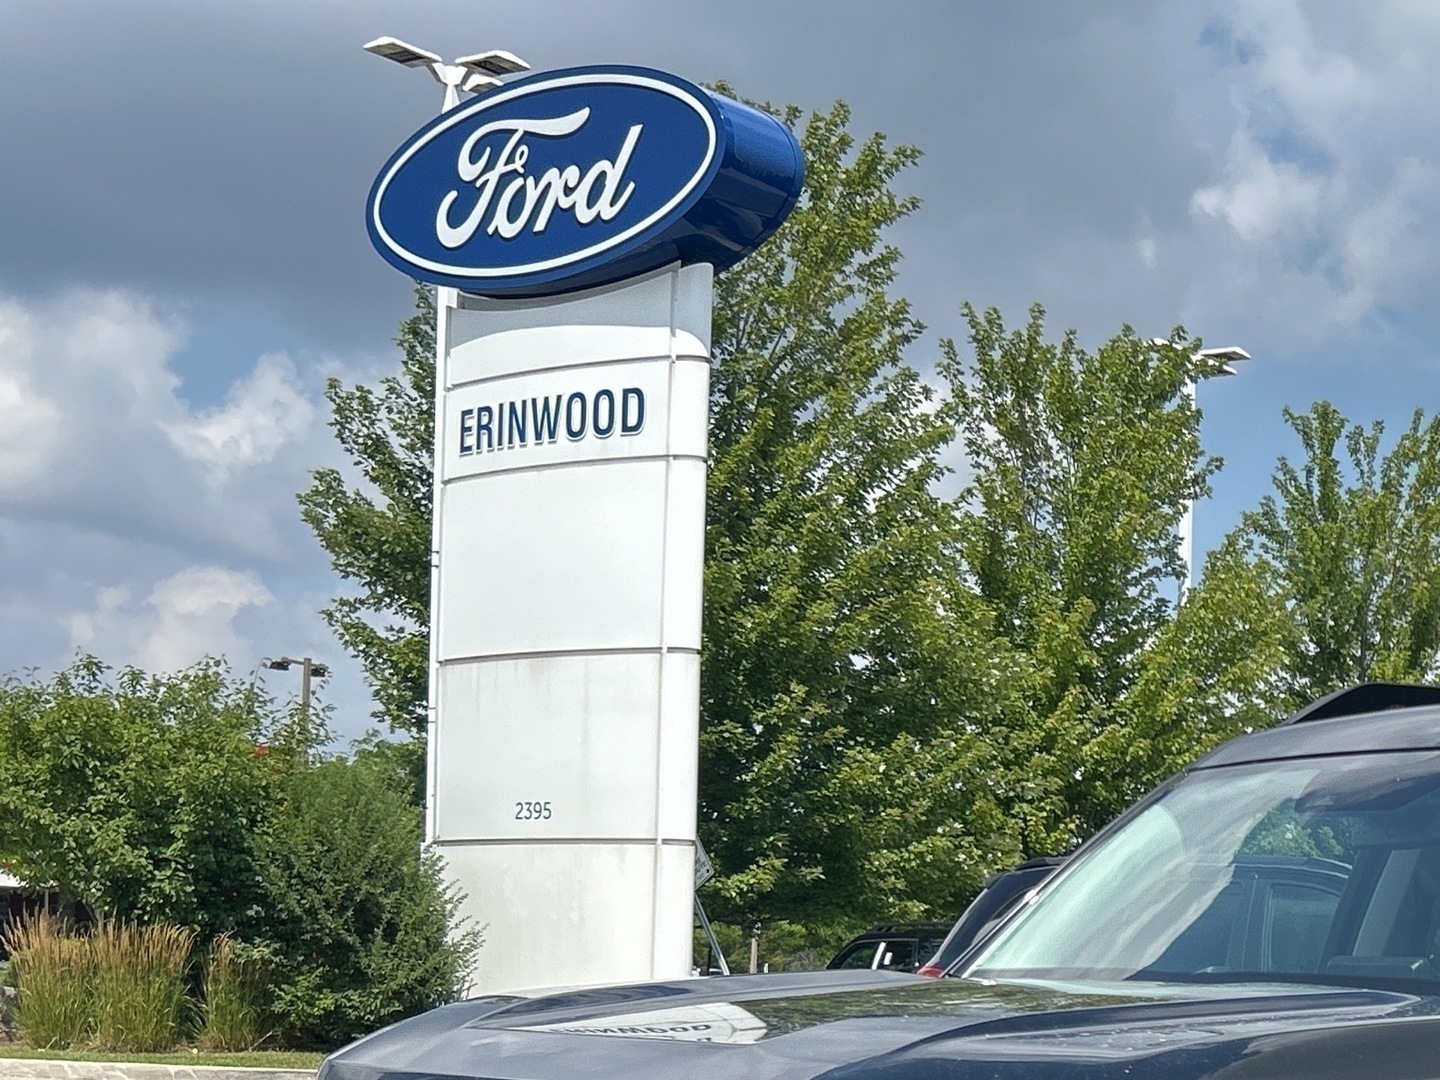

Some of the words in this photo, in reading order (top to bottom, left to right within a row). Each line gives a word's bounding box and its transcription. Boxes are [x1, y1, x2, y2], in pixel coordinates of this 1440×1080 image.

[436, 106, 644, 248] Ford
[459, 387, 646, 457] ERINWOOD
[514, 801, 552, 820] 2395
